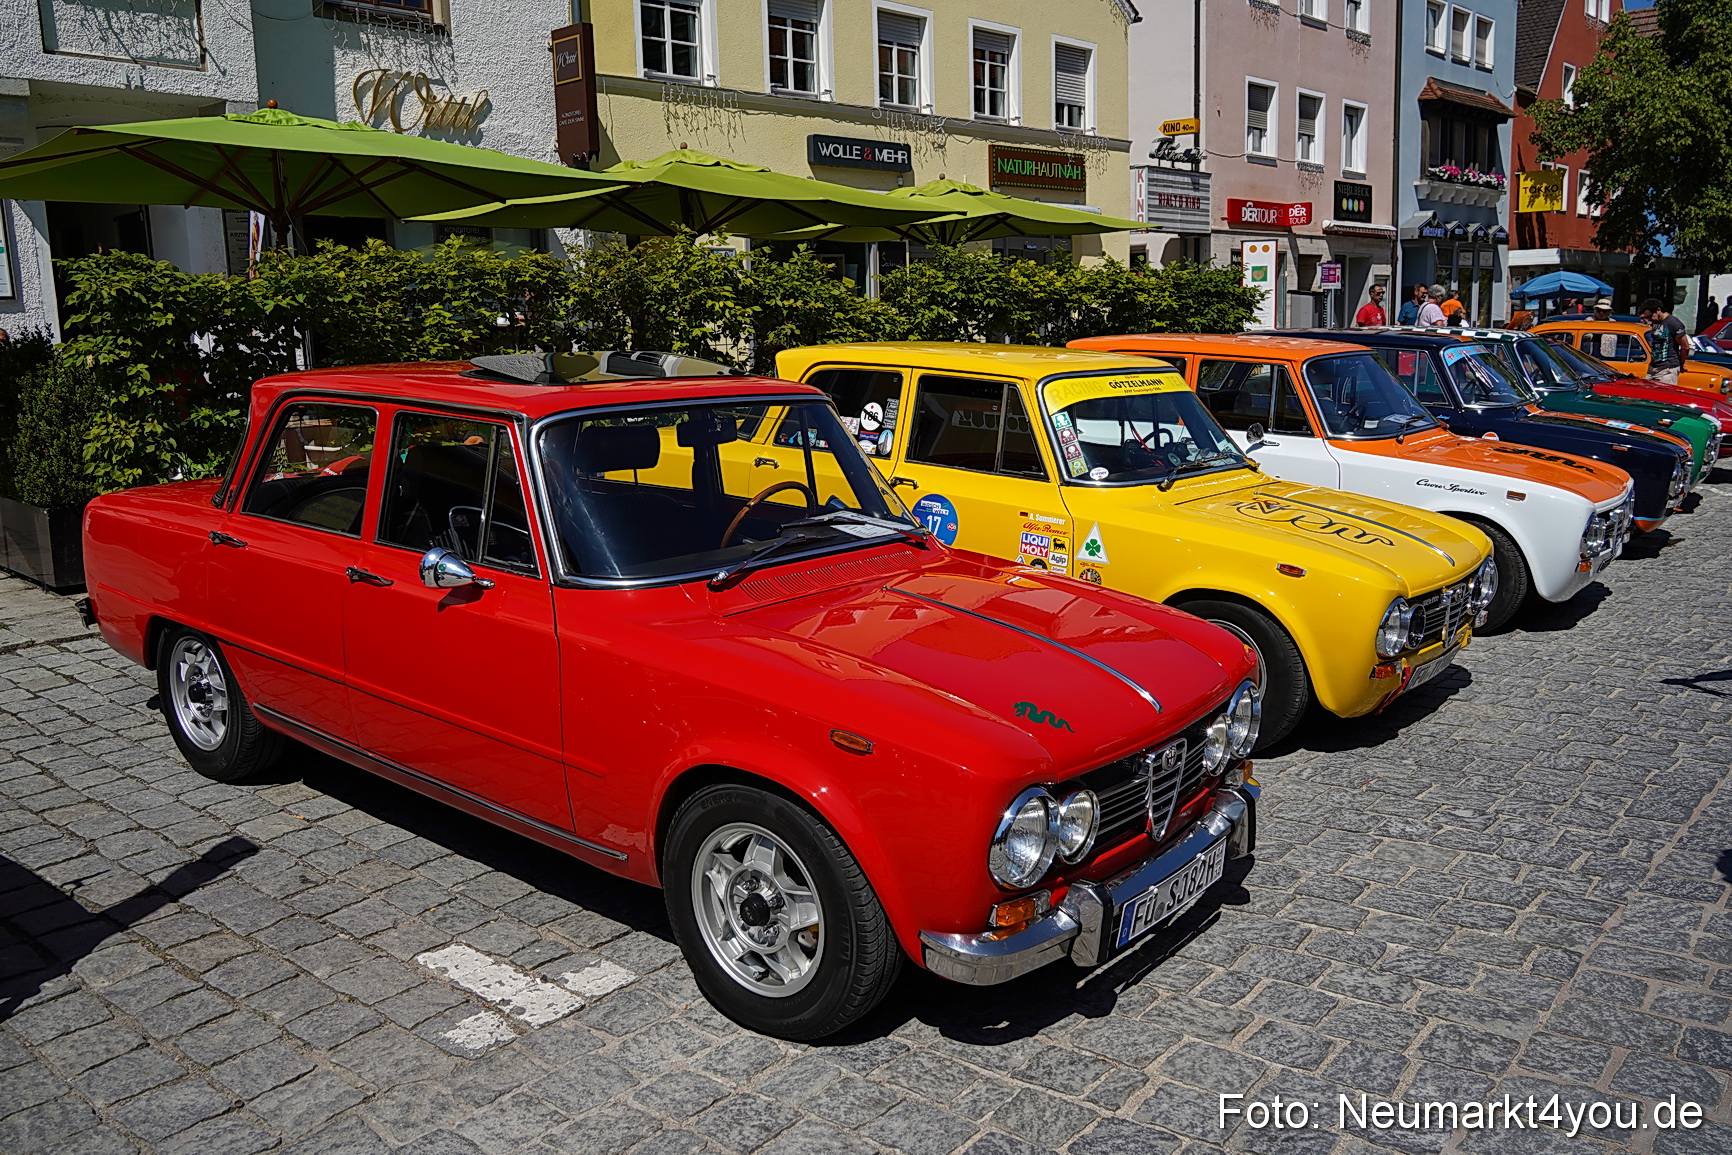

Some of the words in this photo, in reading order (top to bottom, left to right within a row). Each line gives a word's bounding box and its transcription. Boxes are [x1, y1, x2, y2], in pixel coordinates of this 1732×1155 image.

[353, 69, 489, 133] Wittl
[1163, 122, 1181, 133] KINO
[818, 142, 862, 160] WOLLE
[863, 147, 873, 161] &
[875, 148, 908, 164] MEHR
[997, 157, 1081, 180] NATURHAUTNAH
[1158, 193, 1183, 208] RIALTO
[1185, 196, 1201, 209] KINO
[1289, 205, 1307, 217] DER
[1289, 217, 1307, 225] TOUR
[444, 226, 480, 234] KONDITOREI
[1049, 380, 1105, 402] RACING
[1108, 378, 1165, 390] GÖTZELMANN
[1416, 478, 1443, 489] Cuore
[1443, 483, 1487, 496] Sportivo
[1029, 513, 1035, 521] A.
[926, 514, 942, 536] 17
[1023, 522, 1041, 533] Alfa
[1042, 524, 1069, 536] Romeo
[1022, 534, 1049, 547] LIQUI
[1021, 543, 1049, 557] MOLY
[1051, 554, 1067, 565] Agip
[1131, 891, 1159, 934] FÜ
[1166, 853, 1217, 911] SJ82H
